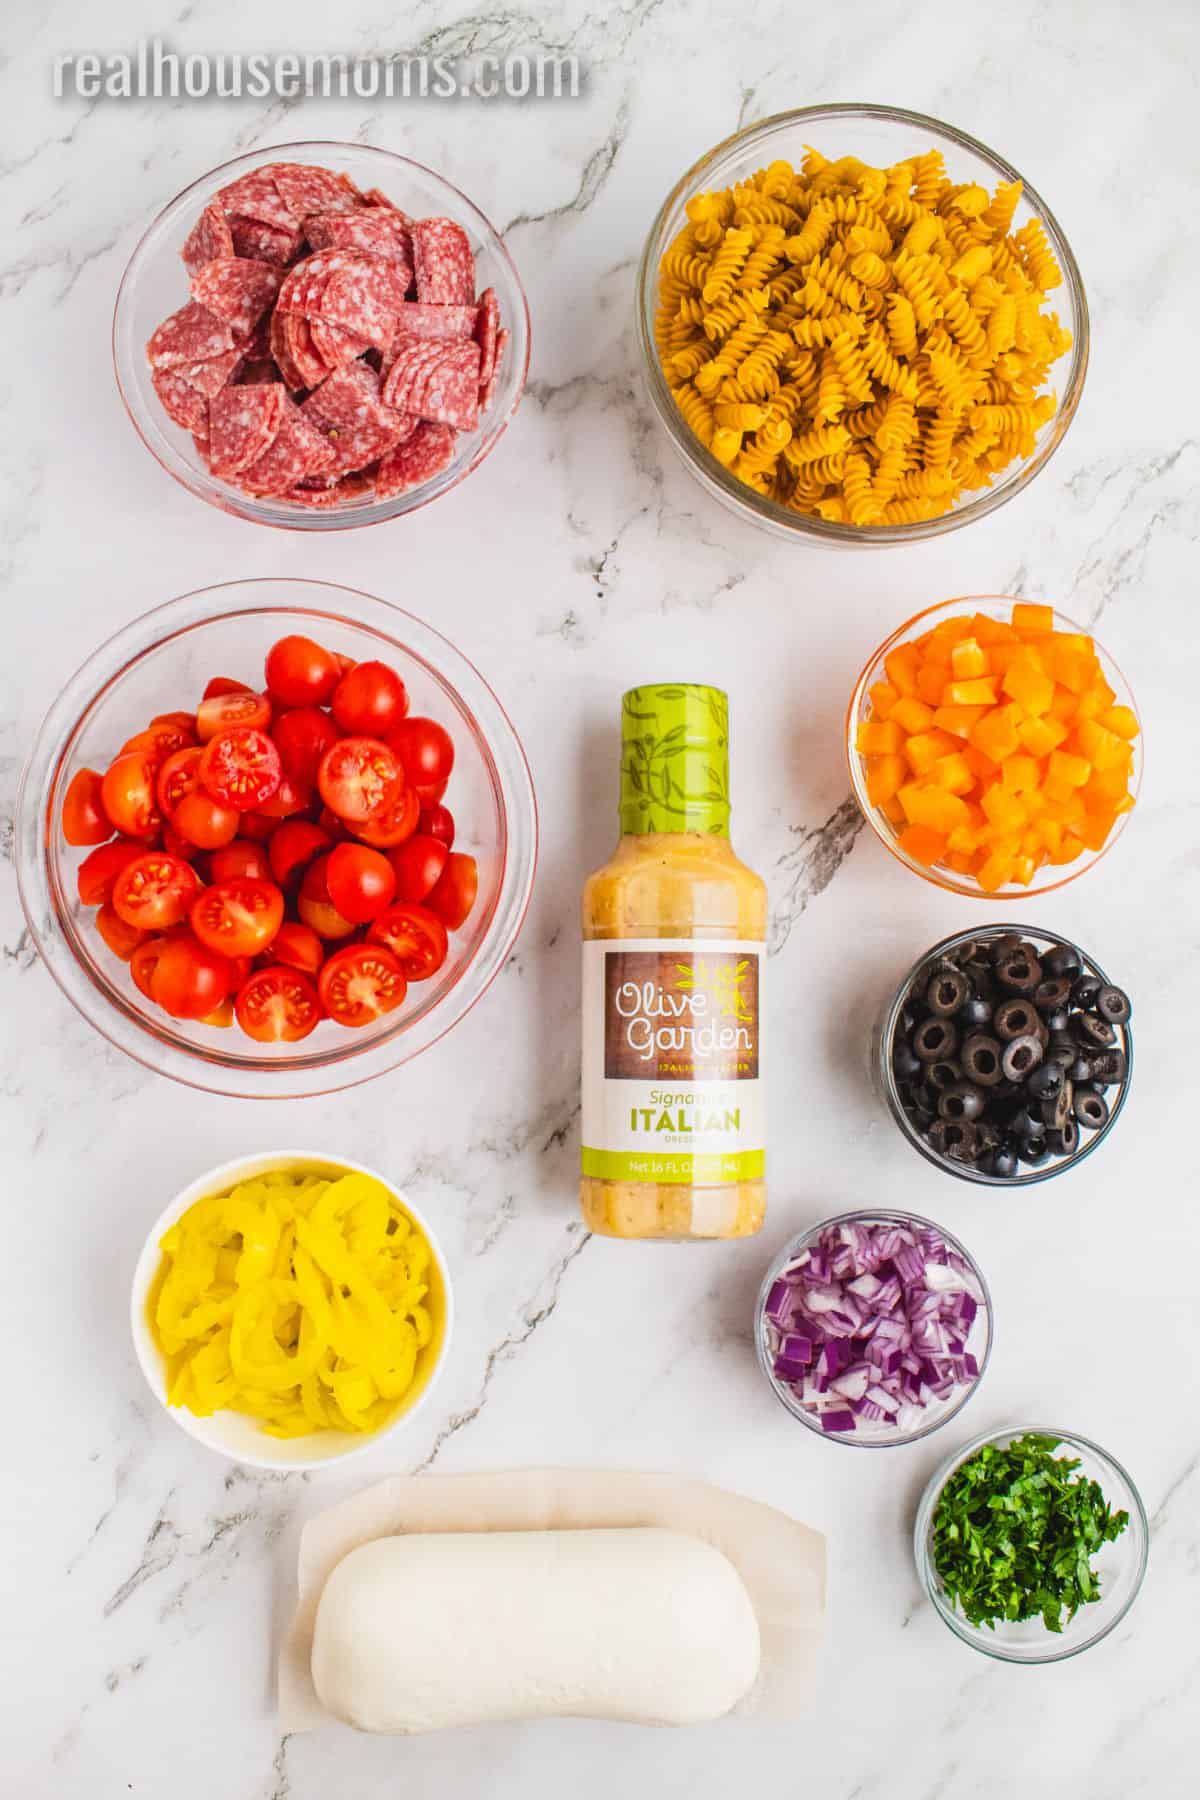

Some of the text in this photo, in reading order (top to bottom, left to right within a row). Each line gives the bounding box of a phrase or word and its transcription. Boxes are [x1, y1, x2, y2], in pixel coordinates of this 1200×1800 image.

[616, 982, 707, 1016] Olive
[627, 1017, 752, 1060] Garden
[631, 1108, 740, 1131] ITALIAN
